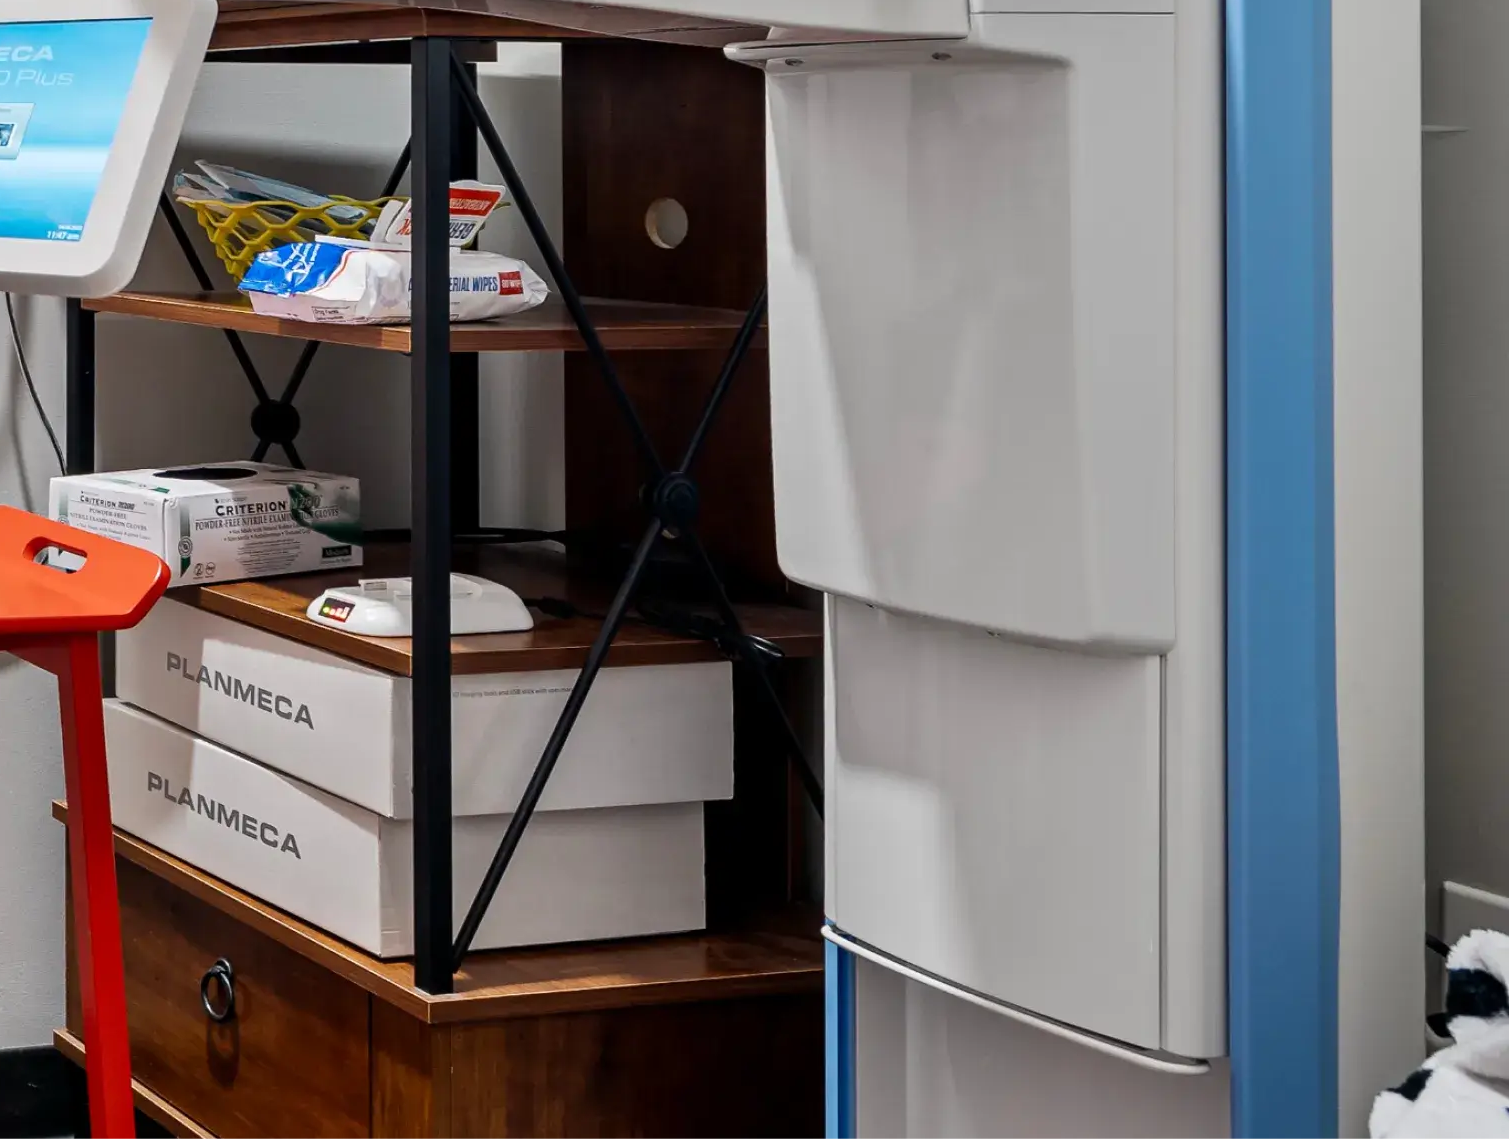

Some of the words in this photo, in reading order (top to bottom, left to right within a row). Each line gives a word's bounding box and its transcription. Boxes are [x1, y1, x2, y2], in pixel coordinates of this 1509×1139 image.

[15, 68, 75, 87] Plus
[472, 276, 499, 292] WIPES
[80, 495, 116, 508] CRITERION
[215, 500, 287, 517] CRITERION
[195, 517, 241, 531] POWDER-FREE
[241, 514, 268, 527] NITRILE
[314, 508, 339, 520] GLOVES
[166, 651, 316, 731] PLANMECA
[146, 770, 302, 860] PLANMECA
